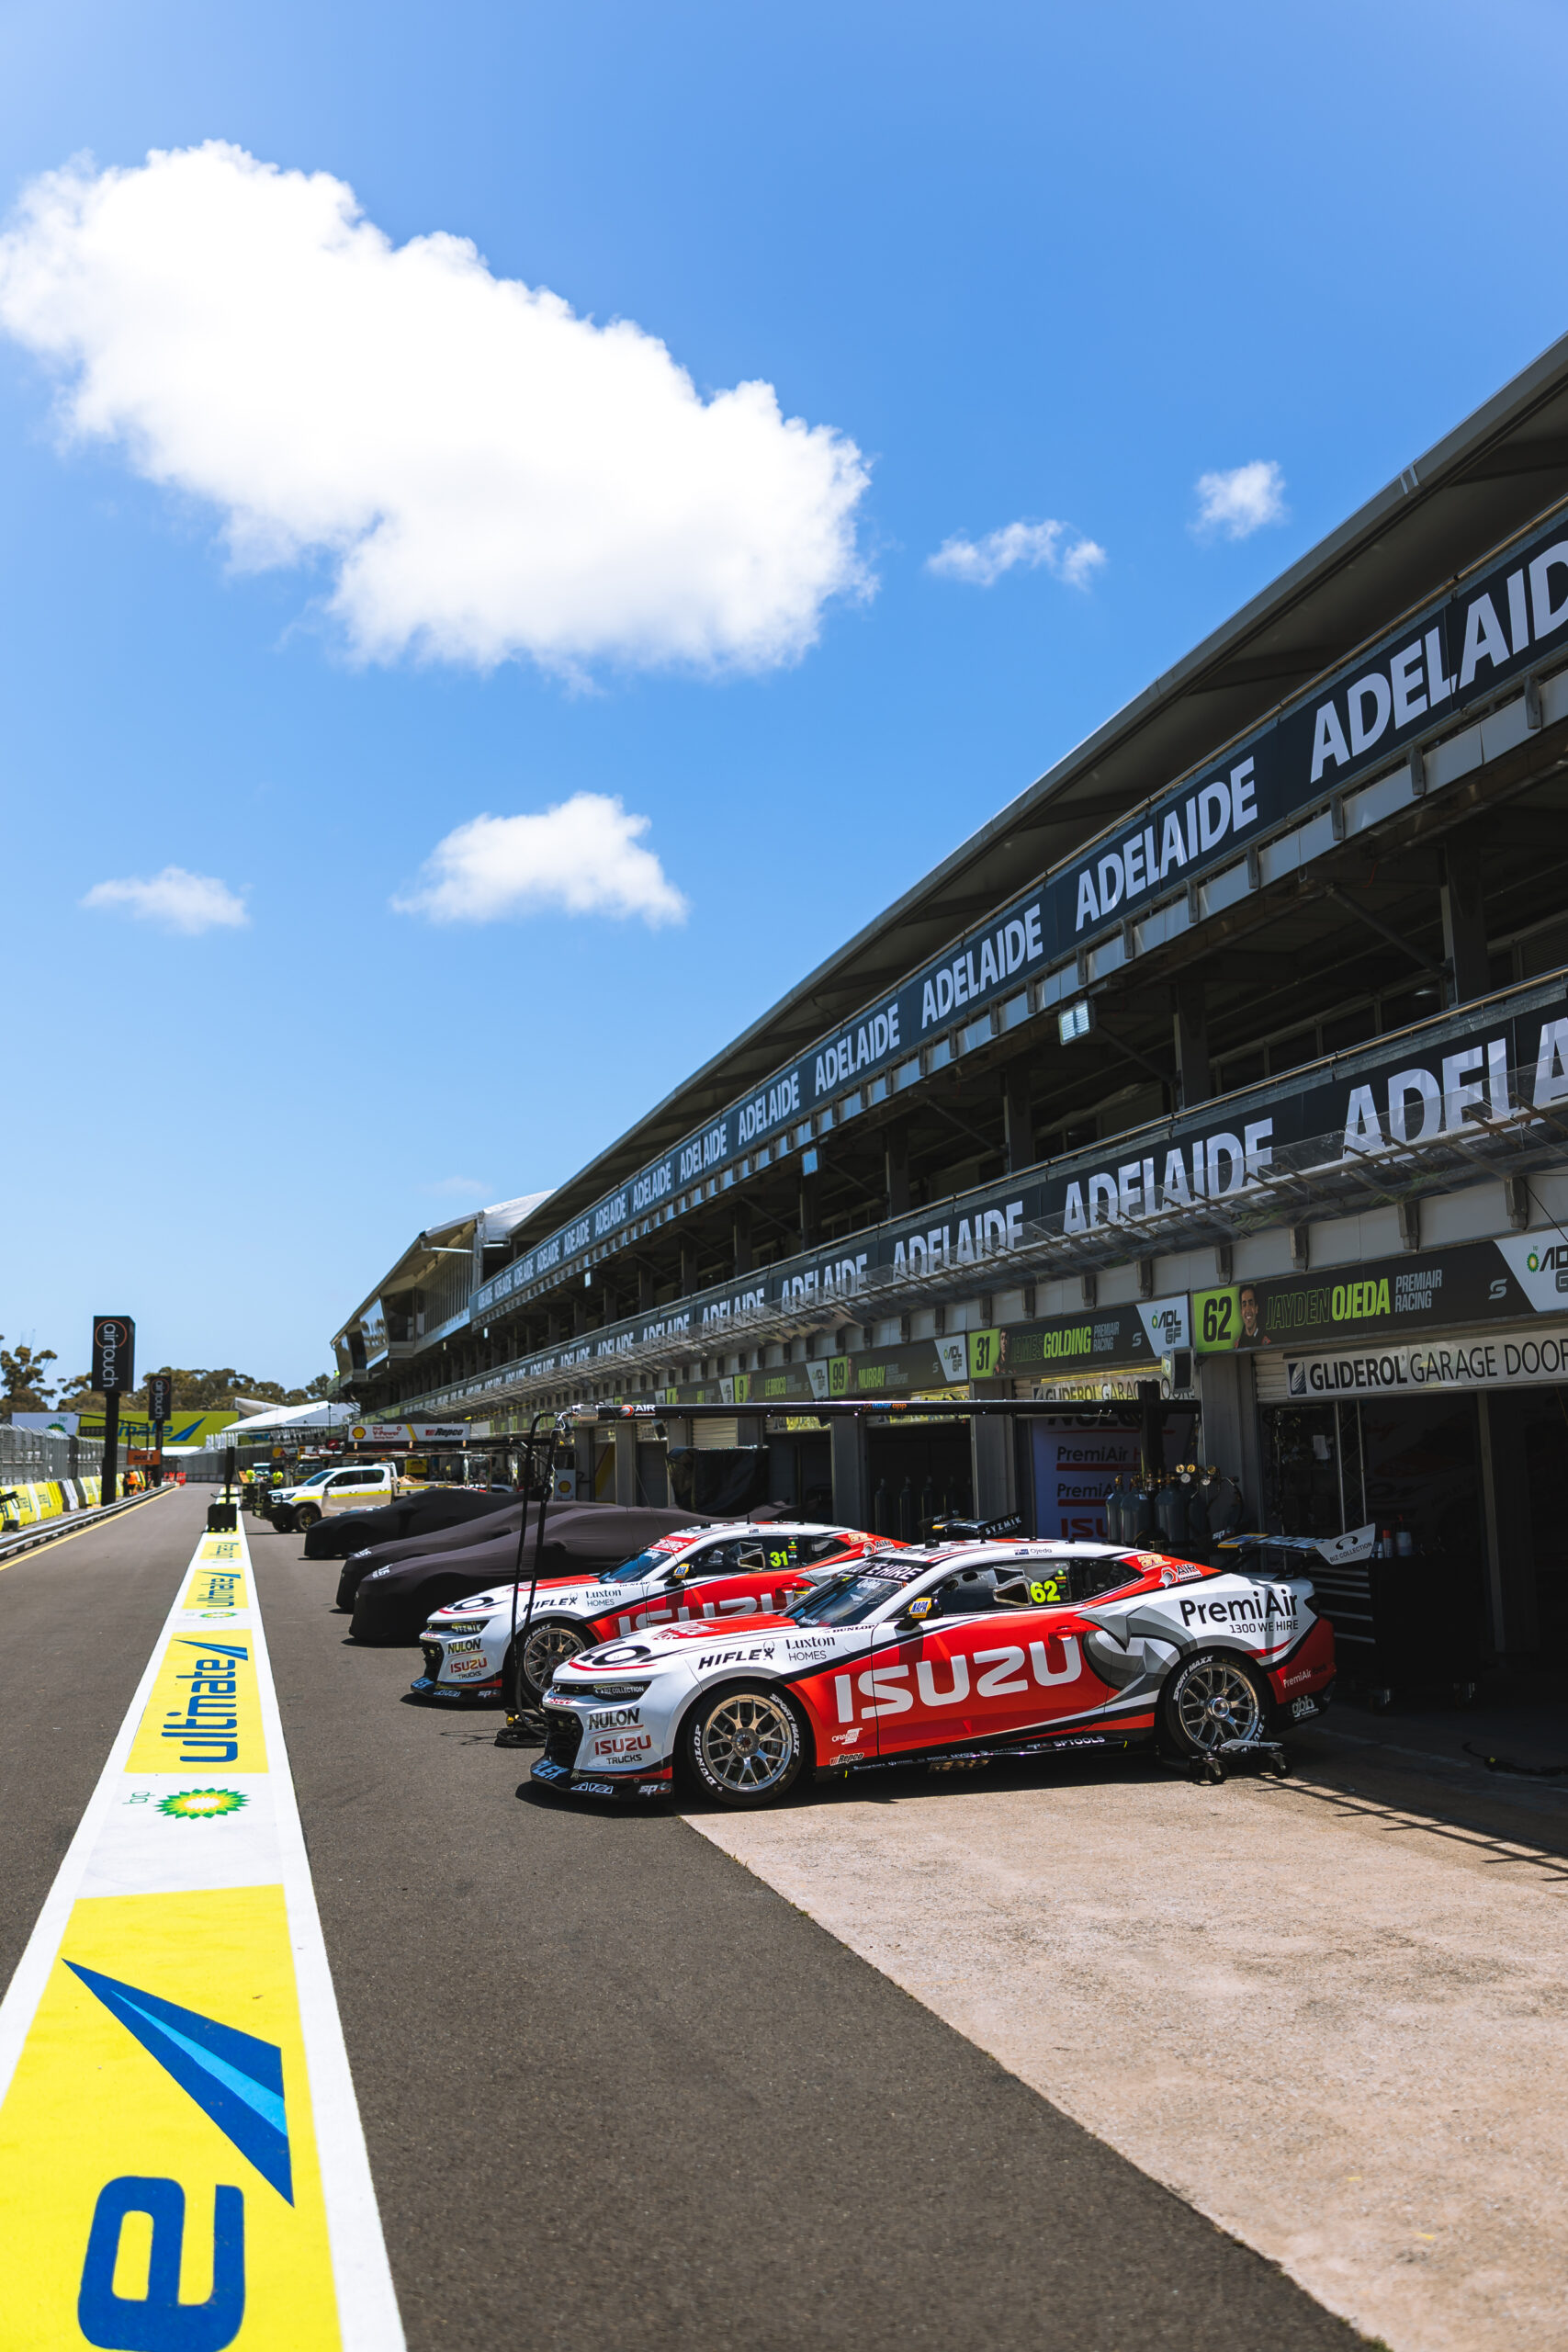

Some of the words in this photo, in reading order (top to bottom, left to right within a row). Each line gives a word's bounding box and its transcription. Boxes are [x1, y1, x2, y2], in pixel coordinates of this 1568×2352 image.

[1075, 755, 1258, 932] ADELAIDE
[921, 903, 1043, 1029] ADELAIDE
[815, 1002, 900, 1097] ADELAIDE
[738, 1071, 800, 1146] ADELAIDE
[680, 1123, 728, 1182] ADELAIDE
[633, 1161, 671, 1212] ADELAIDE
[1063, 1117, 1274, 1234] ADELAIDE
[595, 1193, 626, 1237] ADELAIDE
[563, 1219, 590, 1256] ADELAIDE
[893, 1200, 1023, 1283] ADELAIDE
[781, 1253, 867, 1306] ADELAIDE
[1266, 1288, 1330, 1329] JAYDEN
[1332, 1278, 1391, 1321] OJEDA
[1395, 1269, 1443, 1295] PREMIAIR
[1394, 1290, 1432, 1313] RACING
[1203, 1296, 1233, 1342] 62
[976, 1337, 990, 1371] 31
[1043, 1326, 1091, 1359] GOLDING
[102, 1323, 118, 1387] airtouch
[832, 1363, 845, 1390] 99
[858, 1365, 886, 1389] MURRAY
[1309, 1355, 1408, 1391] GLIDEROL
[1410, 1345, 1498, 1383] GARAGE
[635, 1404, 656, 1412] AIR
[434, 1427, 464, 1438] Repco
[1057, 1445, 1129, 1462] PremiAir
[1057, 1483, 1122, 1498] PremiA
[985, 1515, 1022, 1535] SYZMIK
[769, 1551, 789, 1567] 31
[1339, 1542, 1373, 1559] COLLECTION
[874, 1564, 924, 1580] HIRE
[1177, 1564, 1199, 1576] AIR
[585, 1589, 622, 1599] Luxton
[586, 1598, 615, 1607] HOMES
[1030, 1580, 1061, 1603] 62
[911, 1600, 930, 1613] NAPA
[1179, 1589, 1298, 1627] PremiAir
[831, 1624, 875, 1634] DUNLOP
[1229, 1623, 1256, 1634] 1300
[1257, 1622, 1275, 1633] WE
[1276, 1620, 1299, 1632] HIRE
[447, 1638, 481, 1655] NULON
[785, 1636, 836, 1650] Luxton
[450, 1657, 488, 1674] ISUZU
[698, 1643, 775, 1670] HIFLEX
[788, 1650, 827, 1662] HOMES
[1189, 1655, 1213, 1673] MAXX
[457, 1670, 482, 1679] TRUCKS
[834, 1634, 1082, 1724] ISUZU
[1282, 1668, 1313, 1689] PremiAir
[161, 1659, 239, 1763] ultimate
[589, 1707, 640, 1730] NULON
[770, 1693, 795, 1722] SPORT
[791, 1723, 800, 1757] MAXX
[594, 1735, 652, 1755] ISUZU
[1053, 1736, 1106, 1747] SPTOOLS
[606, 1753, 643, 1764] TRUCKS
[694, 1724, 717, 1786] DUNLOP
[838, 1752, 864, 1765] Repco
[122, 1791, 156, 1804] bp
